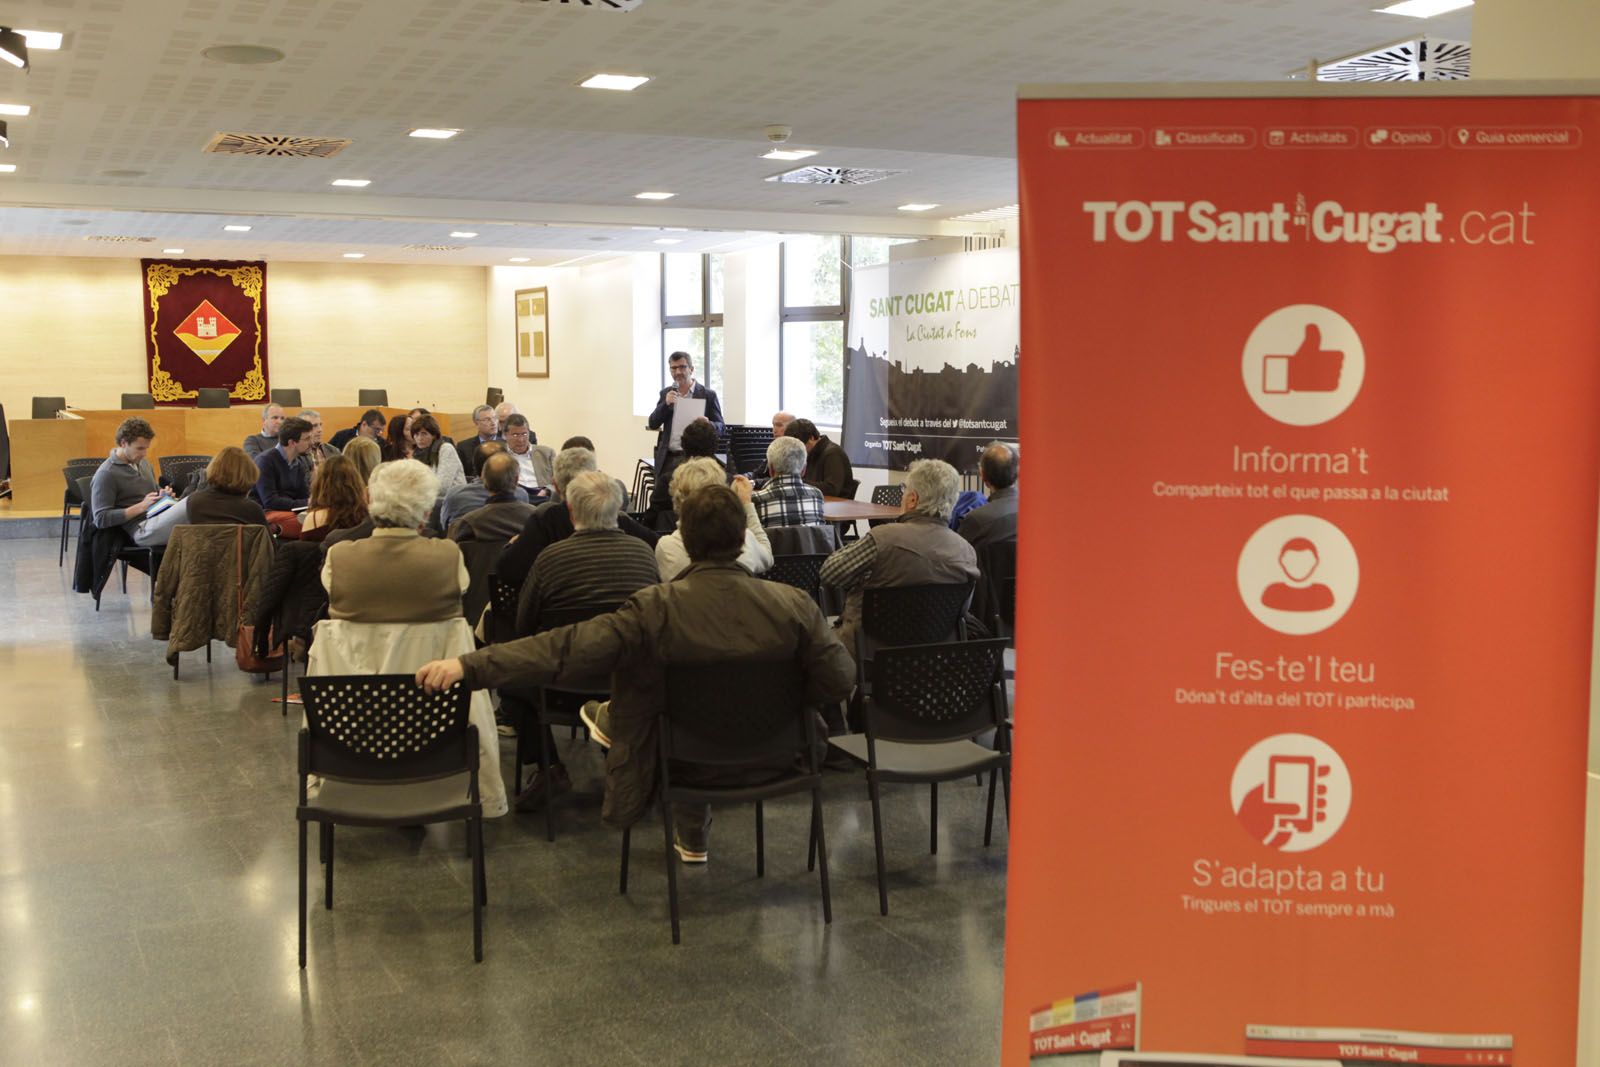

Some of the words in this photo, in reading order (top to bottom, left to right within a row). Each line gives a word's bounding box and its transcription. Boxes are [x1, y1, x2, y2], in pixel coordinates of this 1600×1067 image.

[1075, 132, 1133, 144] Actualitat
[1176, 131, 1245, 144] Classificats
[1290, 131, 1347, 144] Activitats
[1391, 130, 1431, 146] Opinió
[1506, 130, 1568, 144] comercial
[870, 296, 902, 318] SANT
[905, 290, 954, 315] CUGAT
[955, 290, 966, 311] A
[968, 284, 1019, 310] DEBAT
[918, 324, 945, 341] Ciutat
[955, 321, 977, 339] Fons
[903, 417, 919, 428] debat
[925, 417, 942, 428] través
[943, 418, 952, 428] del
[959, 418, 1007, 431] @totsantcugat
[882, 440, 892, 450] TOT
[892, 440, 905, 451] Sant
[906, 441, 922, 454] Cugat
[1232, 445, 1369, 474] Informa't
[1152, 481, 1243, 500] Comparteix
[1247, 484, 1269, 499] tot
[1272, 484, 1287, 499] el
[1290, 486, 1320, 502] que
[1323, 486, 1368, 502] passa
[1371, 487, 1381, 500] a
[1384, 485, 1398, 500] la
[1402, 485, 1449, 502] ciutat
[1215, 652, 1321, 682] Fes-te'l
[1330, 656, 1375, 683] teu
[1229, 688, 1273, 706] d'alta
[1276, 691, 1301, 706] del
[1304, 692, 1335, 708] TOT
[1337, 692, 1342, 708] i
[1345, 692, 1415, 711] participa
[1192, 859, 1323, 895] S'adapta
[1330, 870, 1347, 891] a
[1355, 866, 1385, 892] tu
[1181, 895, 1241, 914] Tingues
[1244, 897, 1258, 912] el
[1262, 898, 1293, 915] TOT
[1296, 902, 1353, 918] sempre
[1356, 904, 1366, 916] a
[1369, 902, 1395, 918] mà
[1079, 1029, 1112, 1049] Cugat
[1388, 1045, 1418, 1061] Cugat
